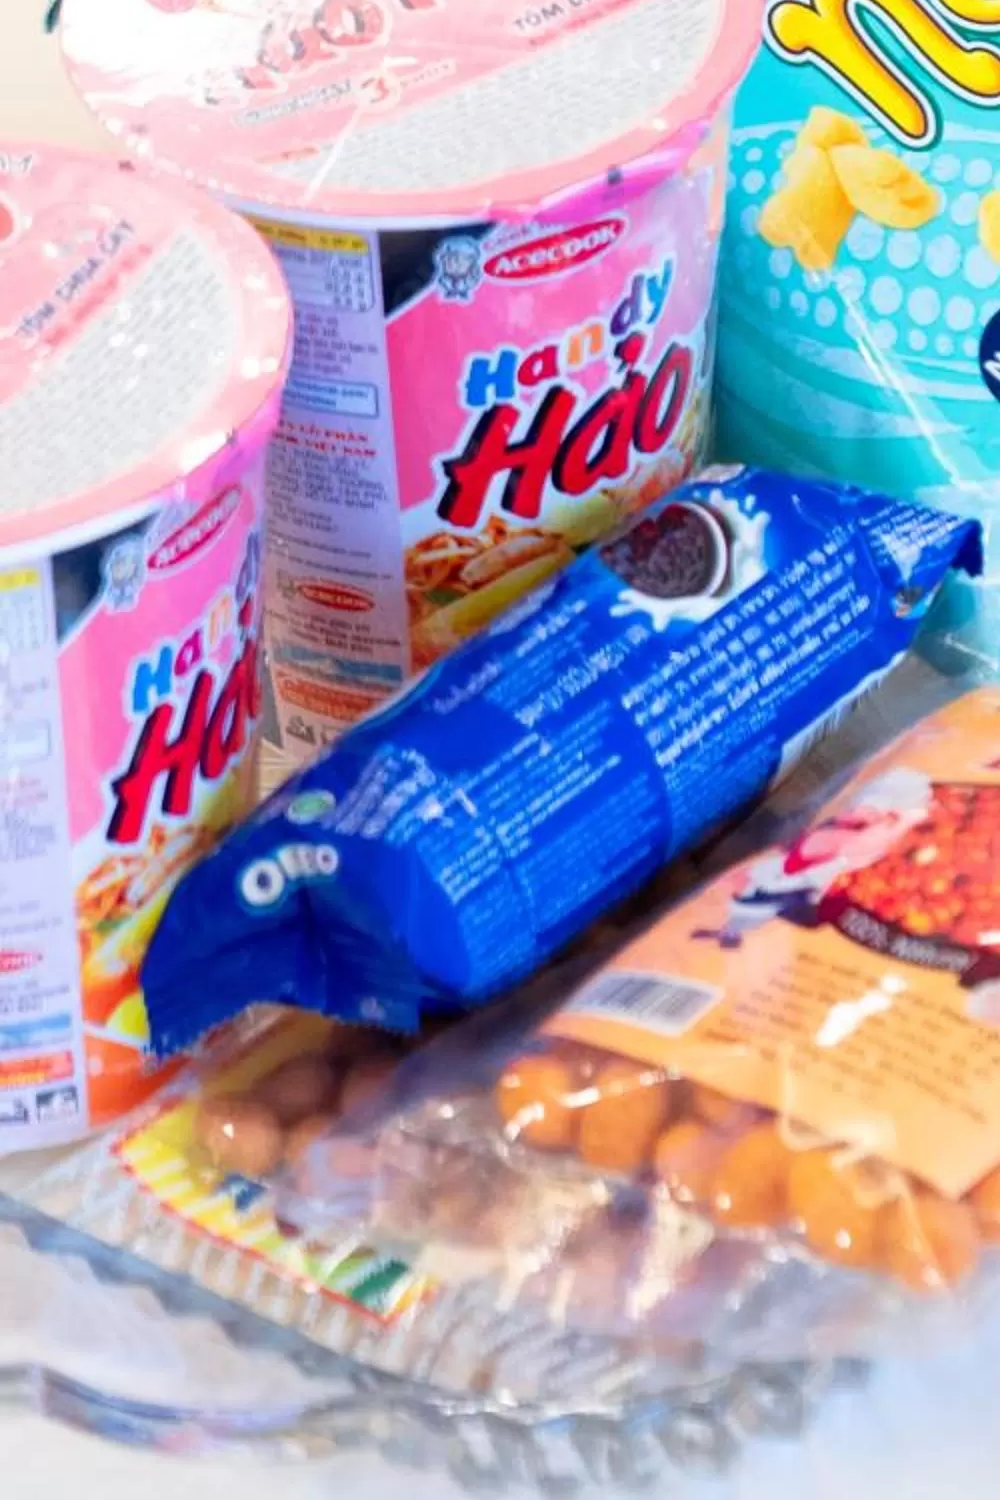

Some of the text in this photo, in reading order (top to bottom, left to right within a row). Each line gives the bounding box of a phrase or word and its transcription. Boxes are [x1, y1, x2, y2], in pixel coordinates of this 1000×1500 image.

[465, 258, 674, 407] Handy
[436, 331, 694, 528] Hảo
[132, 530, 260, 712] Hand
[106, 595, 260, 844] Hả
